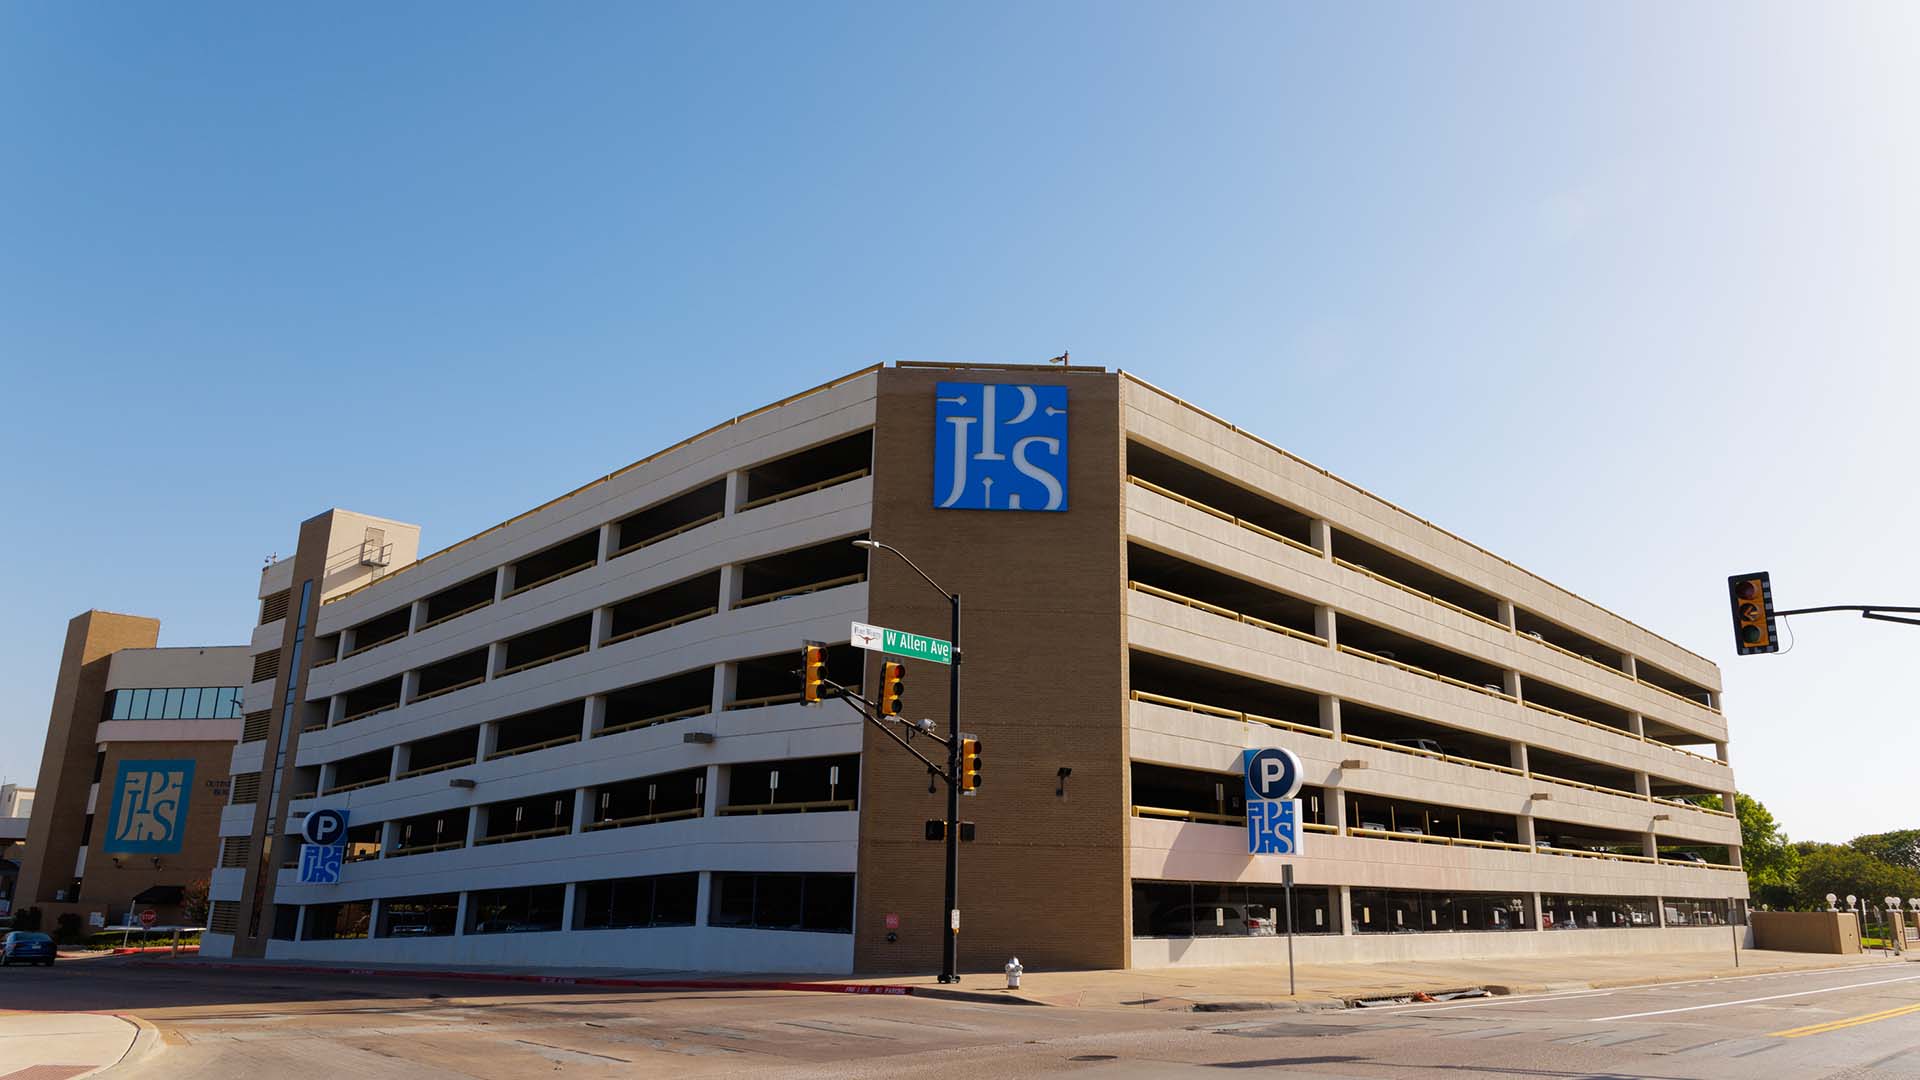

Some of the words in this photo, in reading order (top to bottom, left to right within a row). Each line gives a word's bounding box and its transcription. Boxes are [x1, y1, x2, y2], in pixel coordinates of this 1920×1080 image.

[940, 385, 1063, 510] JPS
[886, 631, 897, 646] W
[900, 634, 927, 653] Allen
[930, 642, 949, 657] Ave
[1261, 758, 1285, 793] P
[316, 816, 337, 841] P
[1249, 800, 1294, 855] JPS
